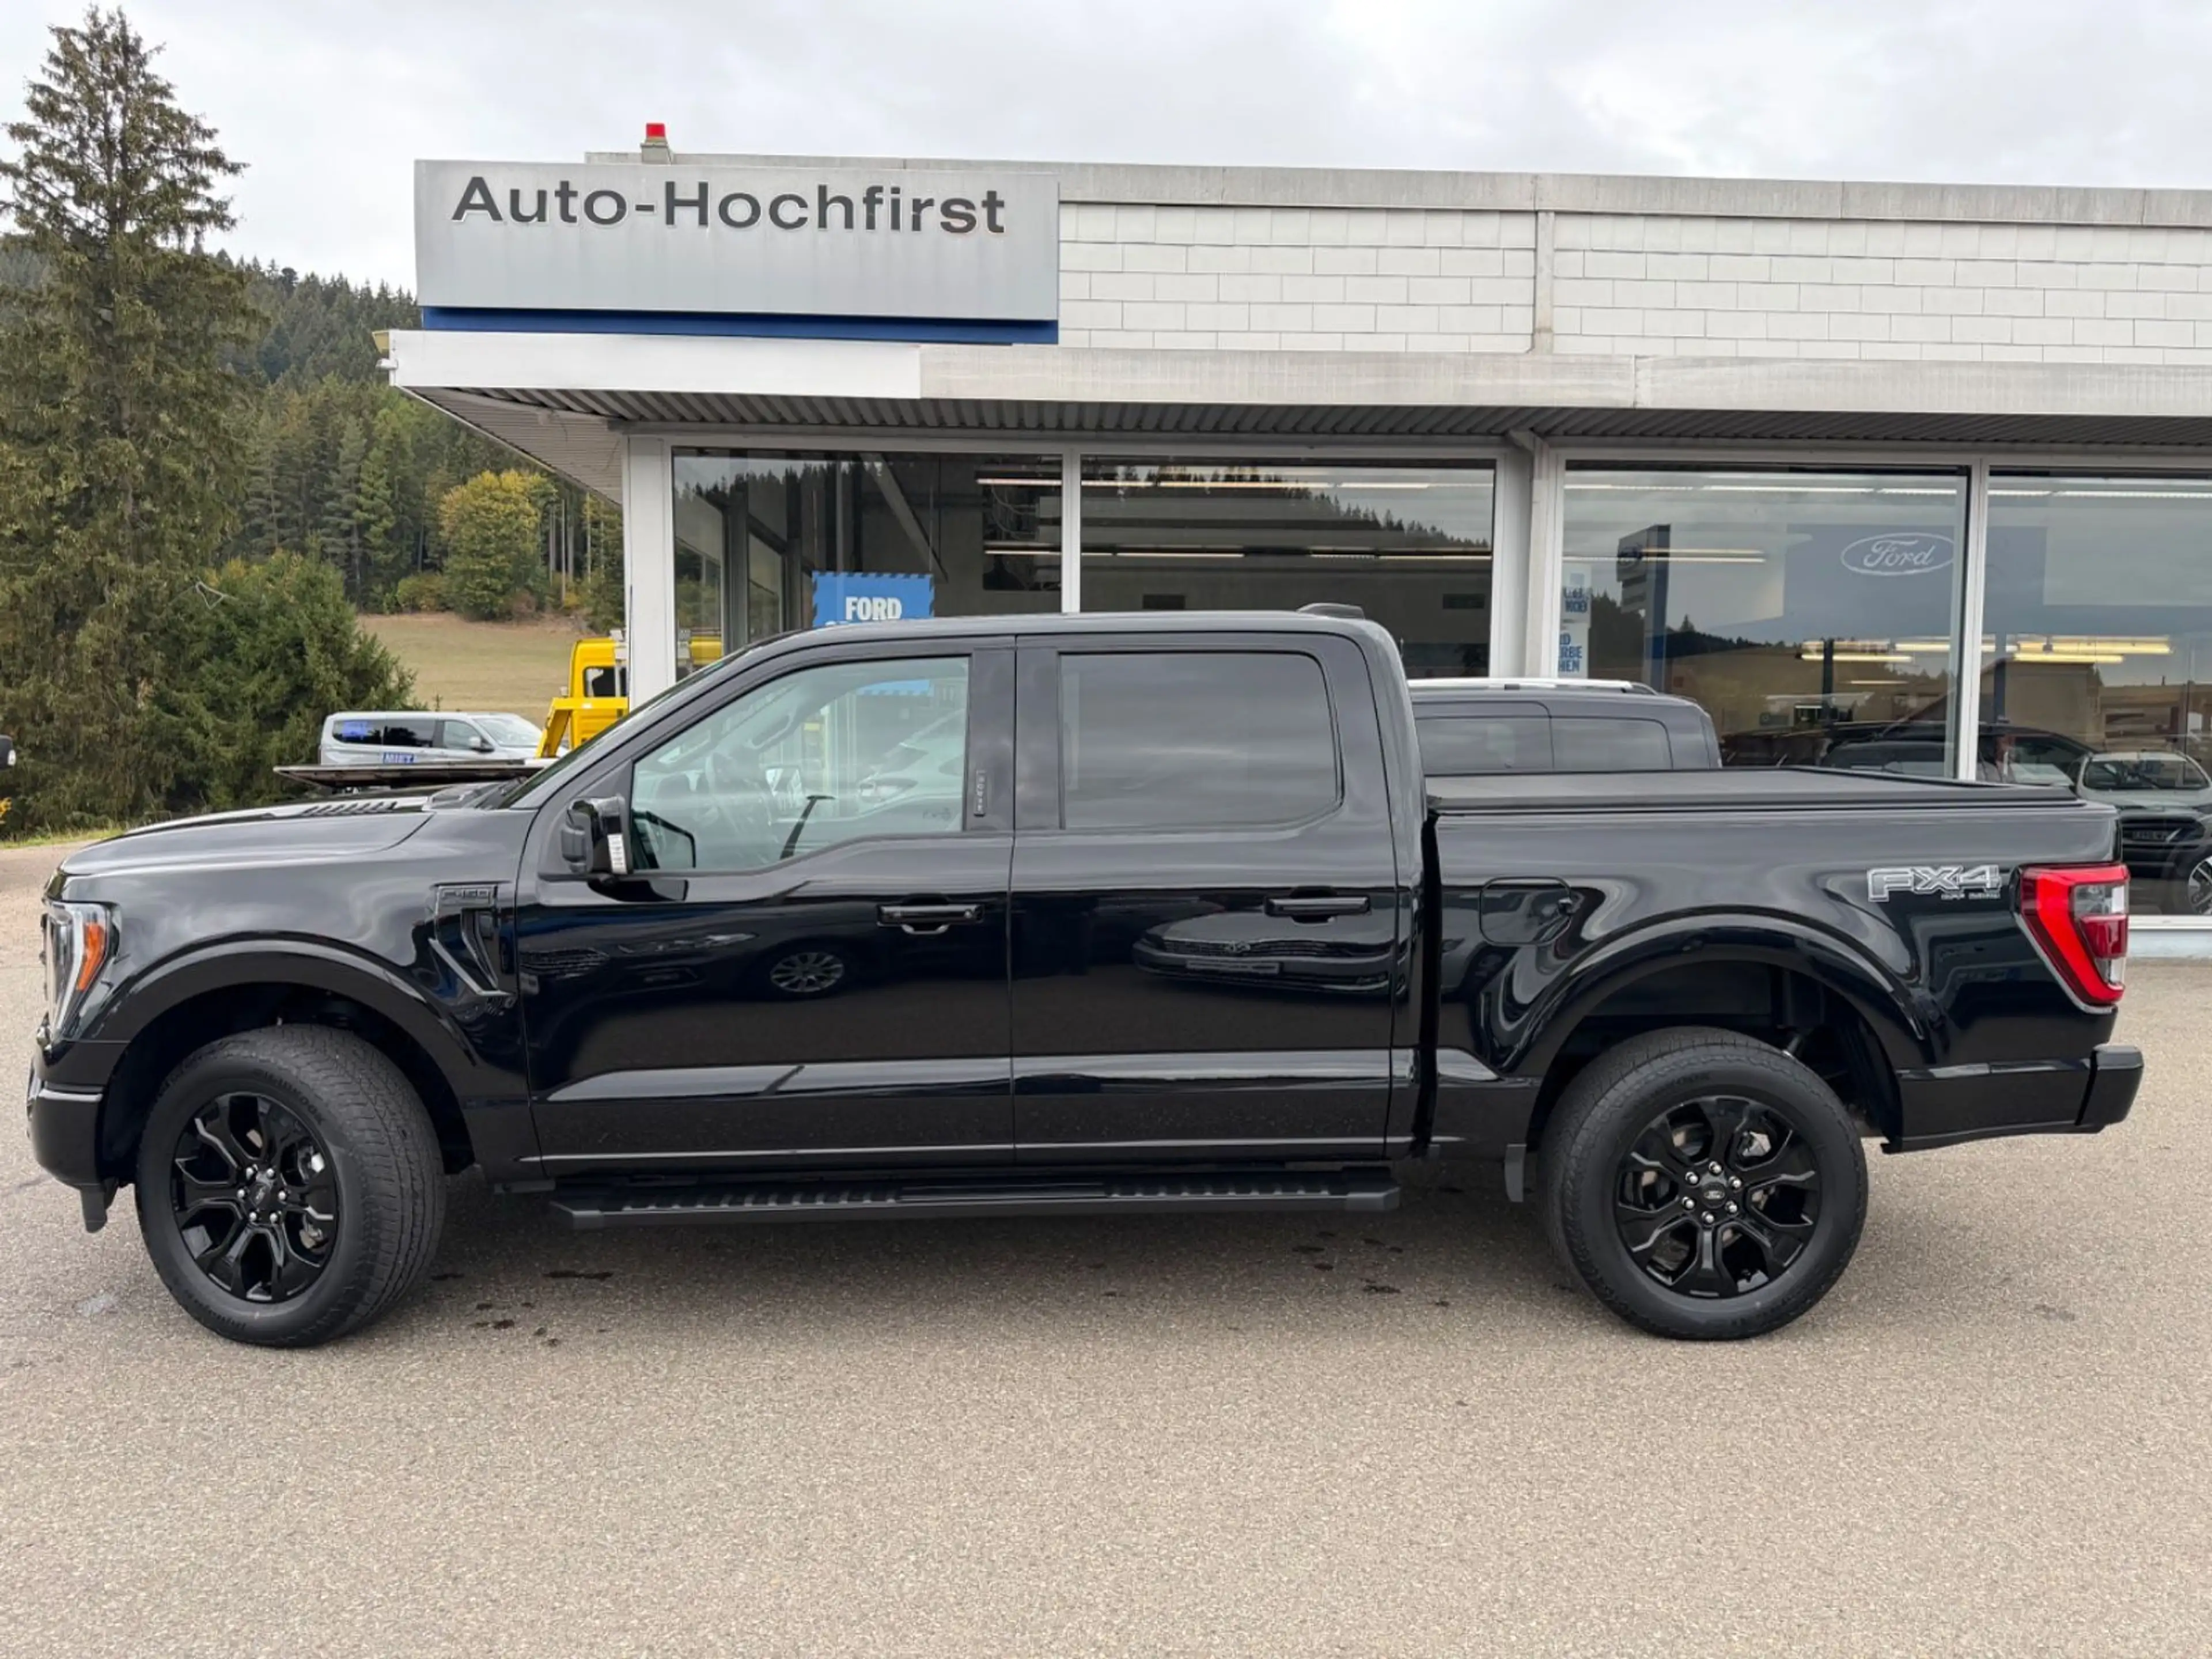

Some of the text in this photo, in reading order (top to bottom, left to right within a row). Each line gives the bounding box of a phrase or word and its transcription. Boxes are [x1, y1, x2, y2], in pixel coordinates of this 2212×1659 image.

[452, 176, 1006, 234] Auto-Hochfirst
[1863, 539, 1936, 567] Ford
[846, 596, 903, 620] FORD
[1866, 864, 2002, 902] FX4
